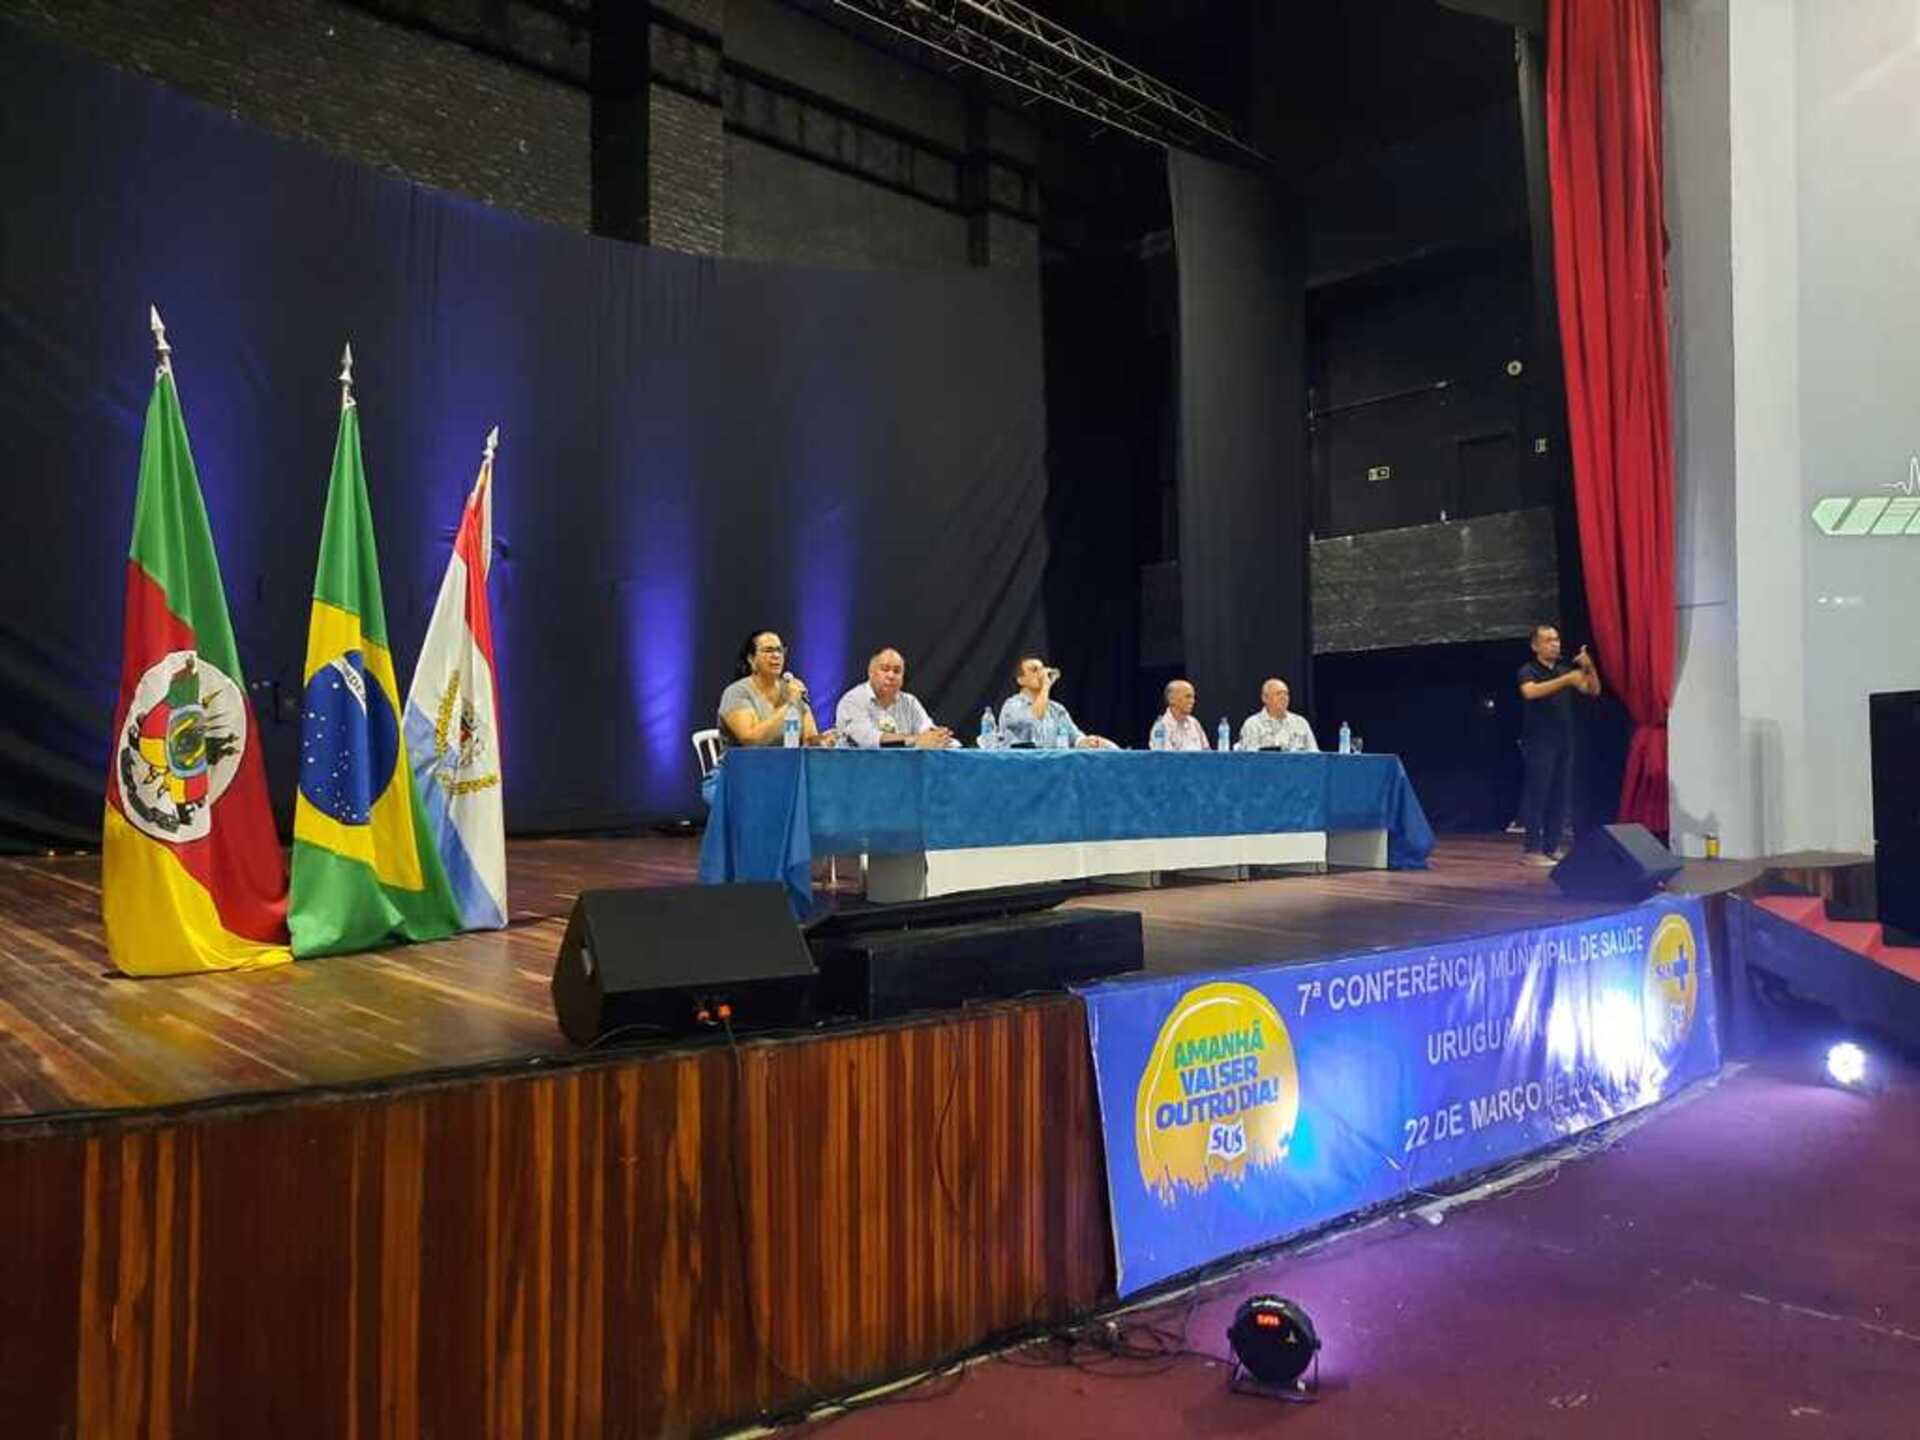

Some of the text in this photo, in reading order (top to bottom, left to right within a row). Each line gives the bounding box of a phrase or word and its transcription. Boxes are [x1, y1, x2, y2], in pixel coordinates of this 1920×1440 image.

[1328, 954, 1485, 1010] CONFERÊNCIA
[1580, 934, 1598, 960] DE
[1174, 1020, 1264, 1070] AMANHÃ
[1180, 1055, 1258, 1095] VAI SER
[1156, 1076, 1279, 1130] OUTRO DIA!
[1404, 1115, 1430, 1152] 22
[1434, 1104, 1465, 1141] DE
[1469, 1081, 1542, 1131] MARÇO
[1211, 1126, 1243, 1154] SUS
